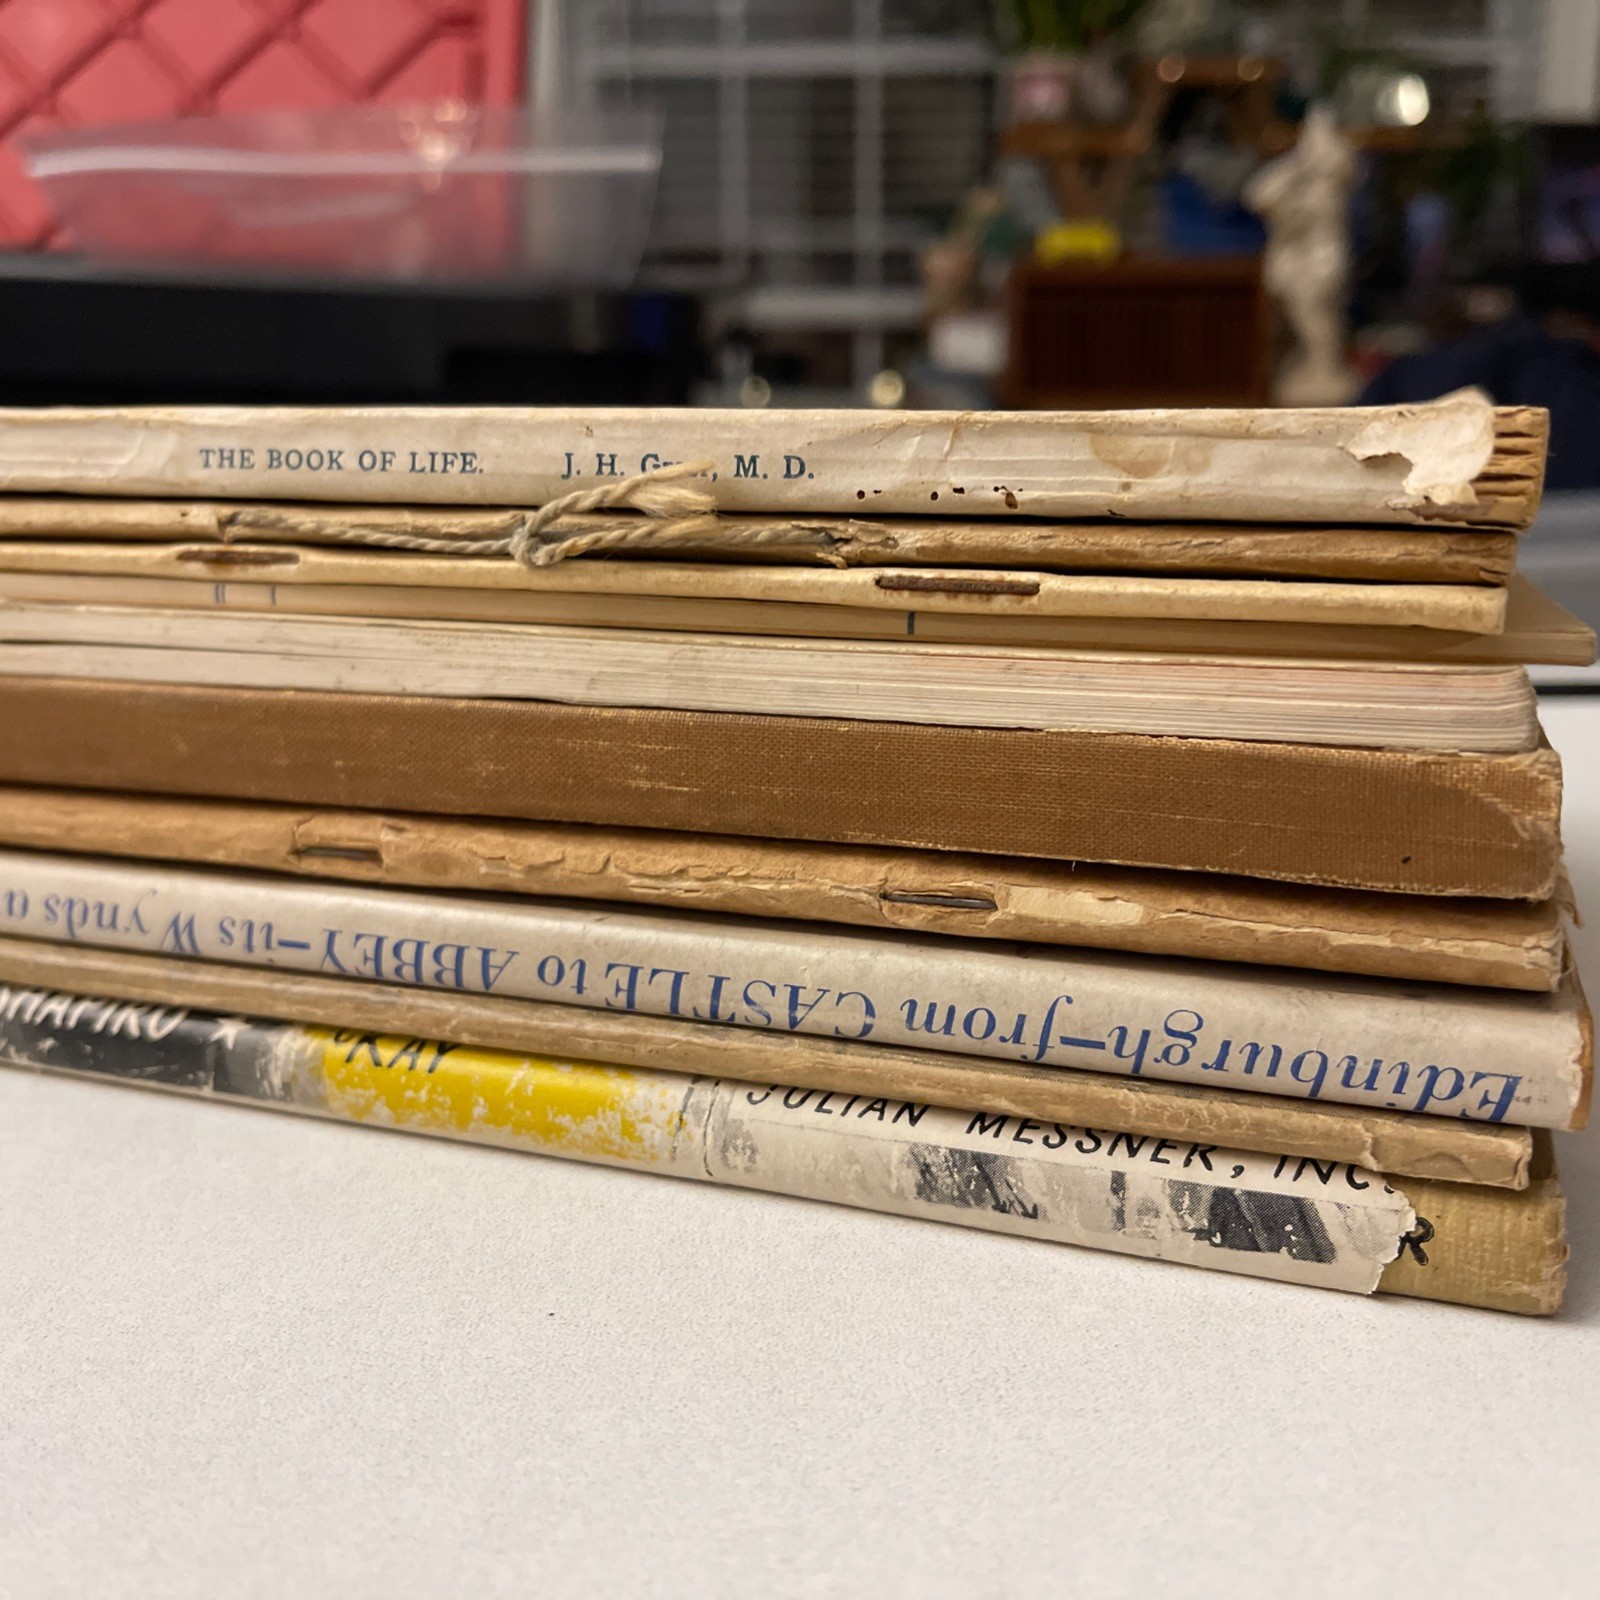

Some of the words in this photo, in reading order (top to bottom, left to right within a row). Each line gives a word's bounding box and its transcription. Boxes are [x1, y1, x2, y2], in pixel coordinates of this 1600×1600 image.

[198, 449, 256, 470] THE
[267, 450, 345, 472] BOOK
[358, 450, 397, 473] OF
[409, 451, 485, 475] LIFE.
[561, 452, 582, 480] J.
[595, 453, 626, 477] H.
[733, 454, 769, 480] M.
[783, 454, 815, 480] D.
[537, 954, 588, 995] to
[605, 961, 877, 1039] CASTLE
[746, 1083, 933, 1127] JULIAN
[965, 1110, 1246, 1179] MESSNER,
